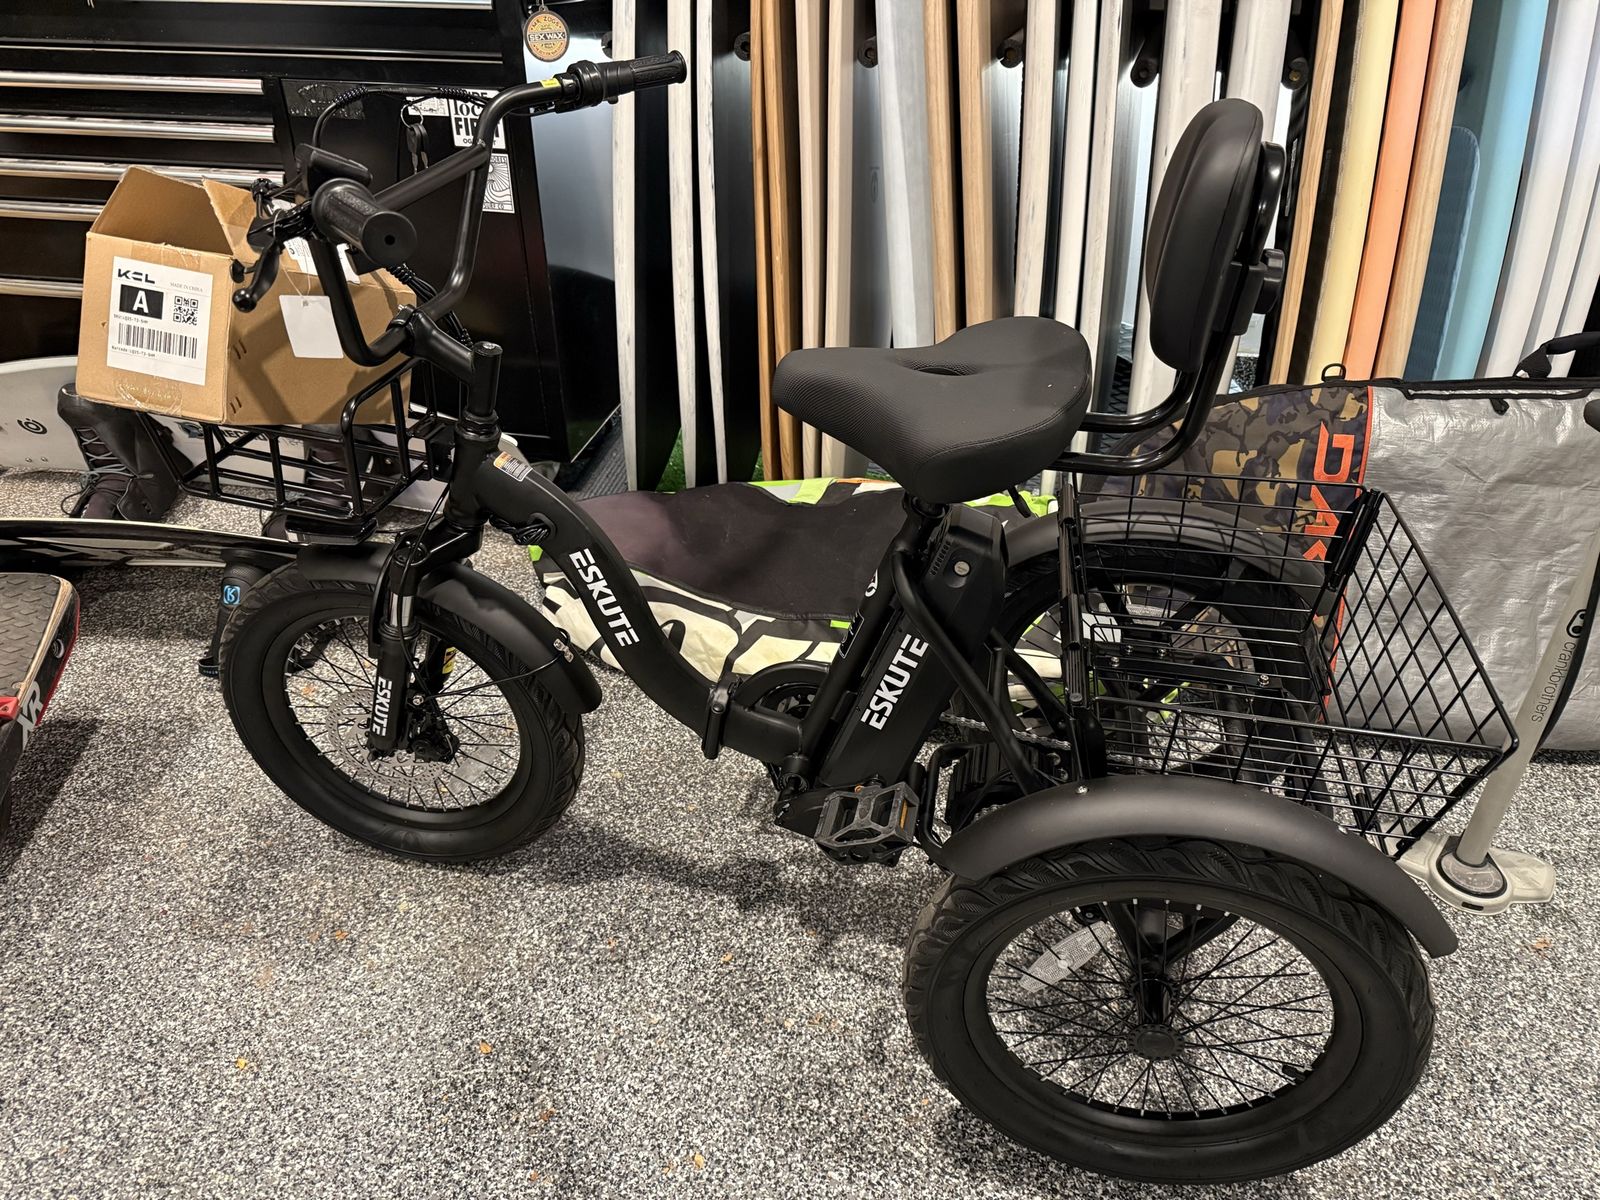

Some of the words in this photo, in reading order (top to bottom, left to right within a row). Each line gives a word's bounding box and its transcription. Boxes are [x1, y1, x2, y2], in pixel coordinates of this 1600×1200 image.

[529, 33, 545, 41] SEX
[545, 32, 563, 40] WAX
[132, 289, 149, 314] A
[170, 281, 183, 289] MADE
[568, 548, 640, 647] ESKUTE
[372, 676, 393, 737] ESKUTE
[860, 633, 930, 731] ESKUTE
[1531, 641, 1577, 723] crankbrothers
